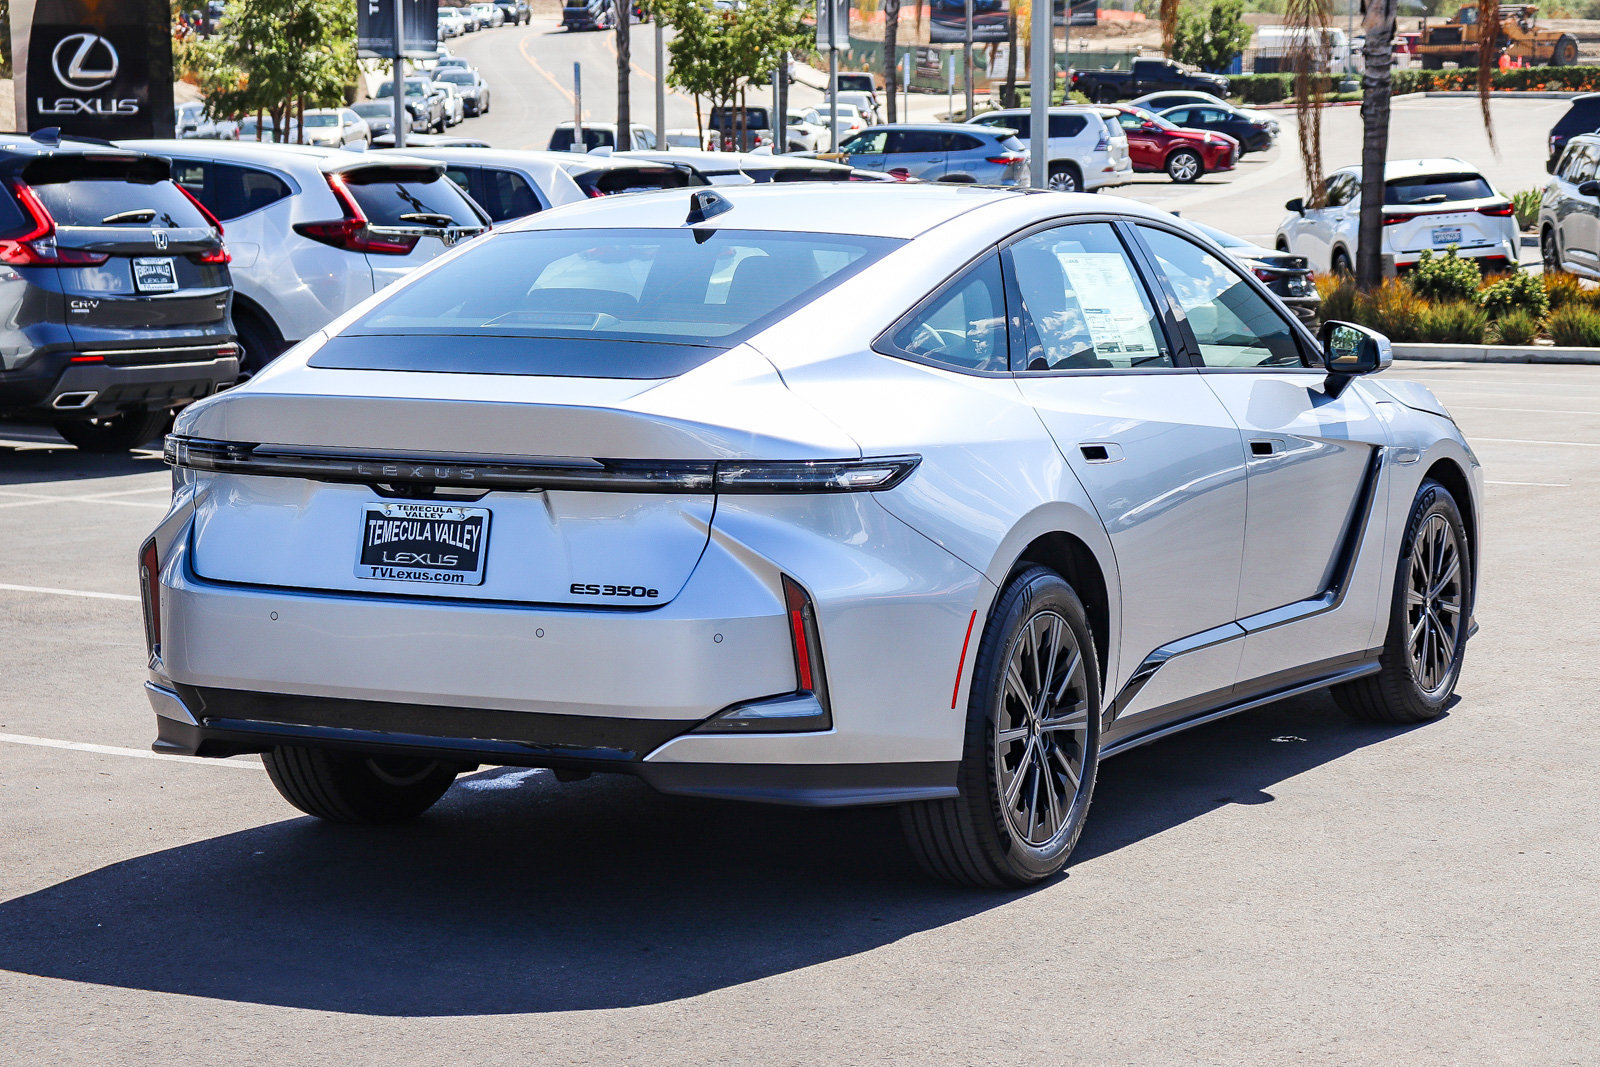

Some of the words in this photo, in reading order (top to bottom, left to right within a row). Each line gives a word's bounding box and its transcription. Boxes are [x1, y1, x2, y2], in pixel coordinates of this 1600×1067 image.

[37, 97, 139, 115] LEXUS
[358, 464, 475, 480] LEXUS
[397, 504, 453, 514] TEMECULA
[368, 519, 431, 547] TEMECULA
[434, 522, 480, 553] VALLEY
[382, 551, 459, 566] LEXUS
[370, 566, 464, 583] TVLexus.com
[570, 583, 600, 595] ES
[602, 585, 659, 598] 350e
